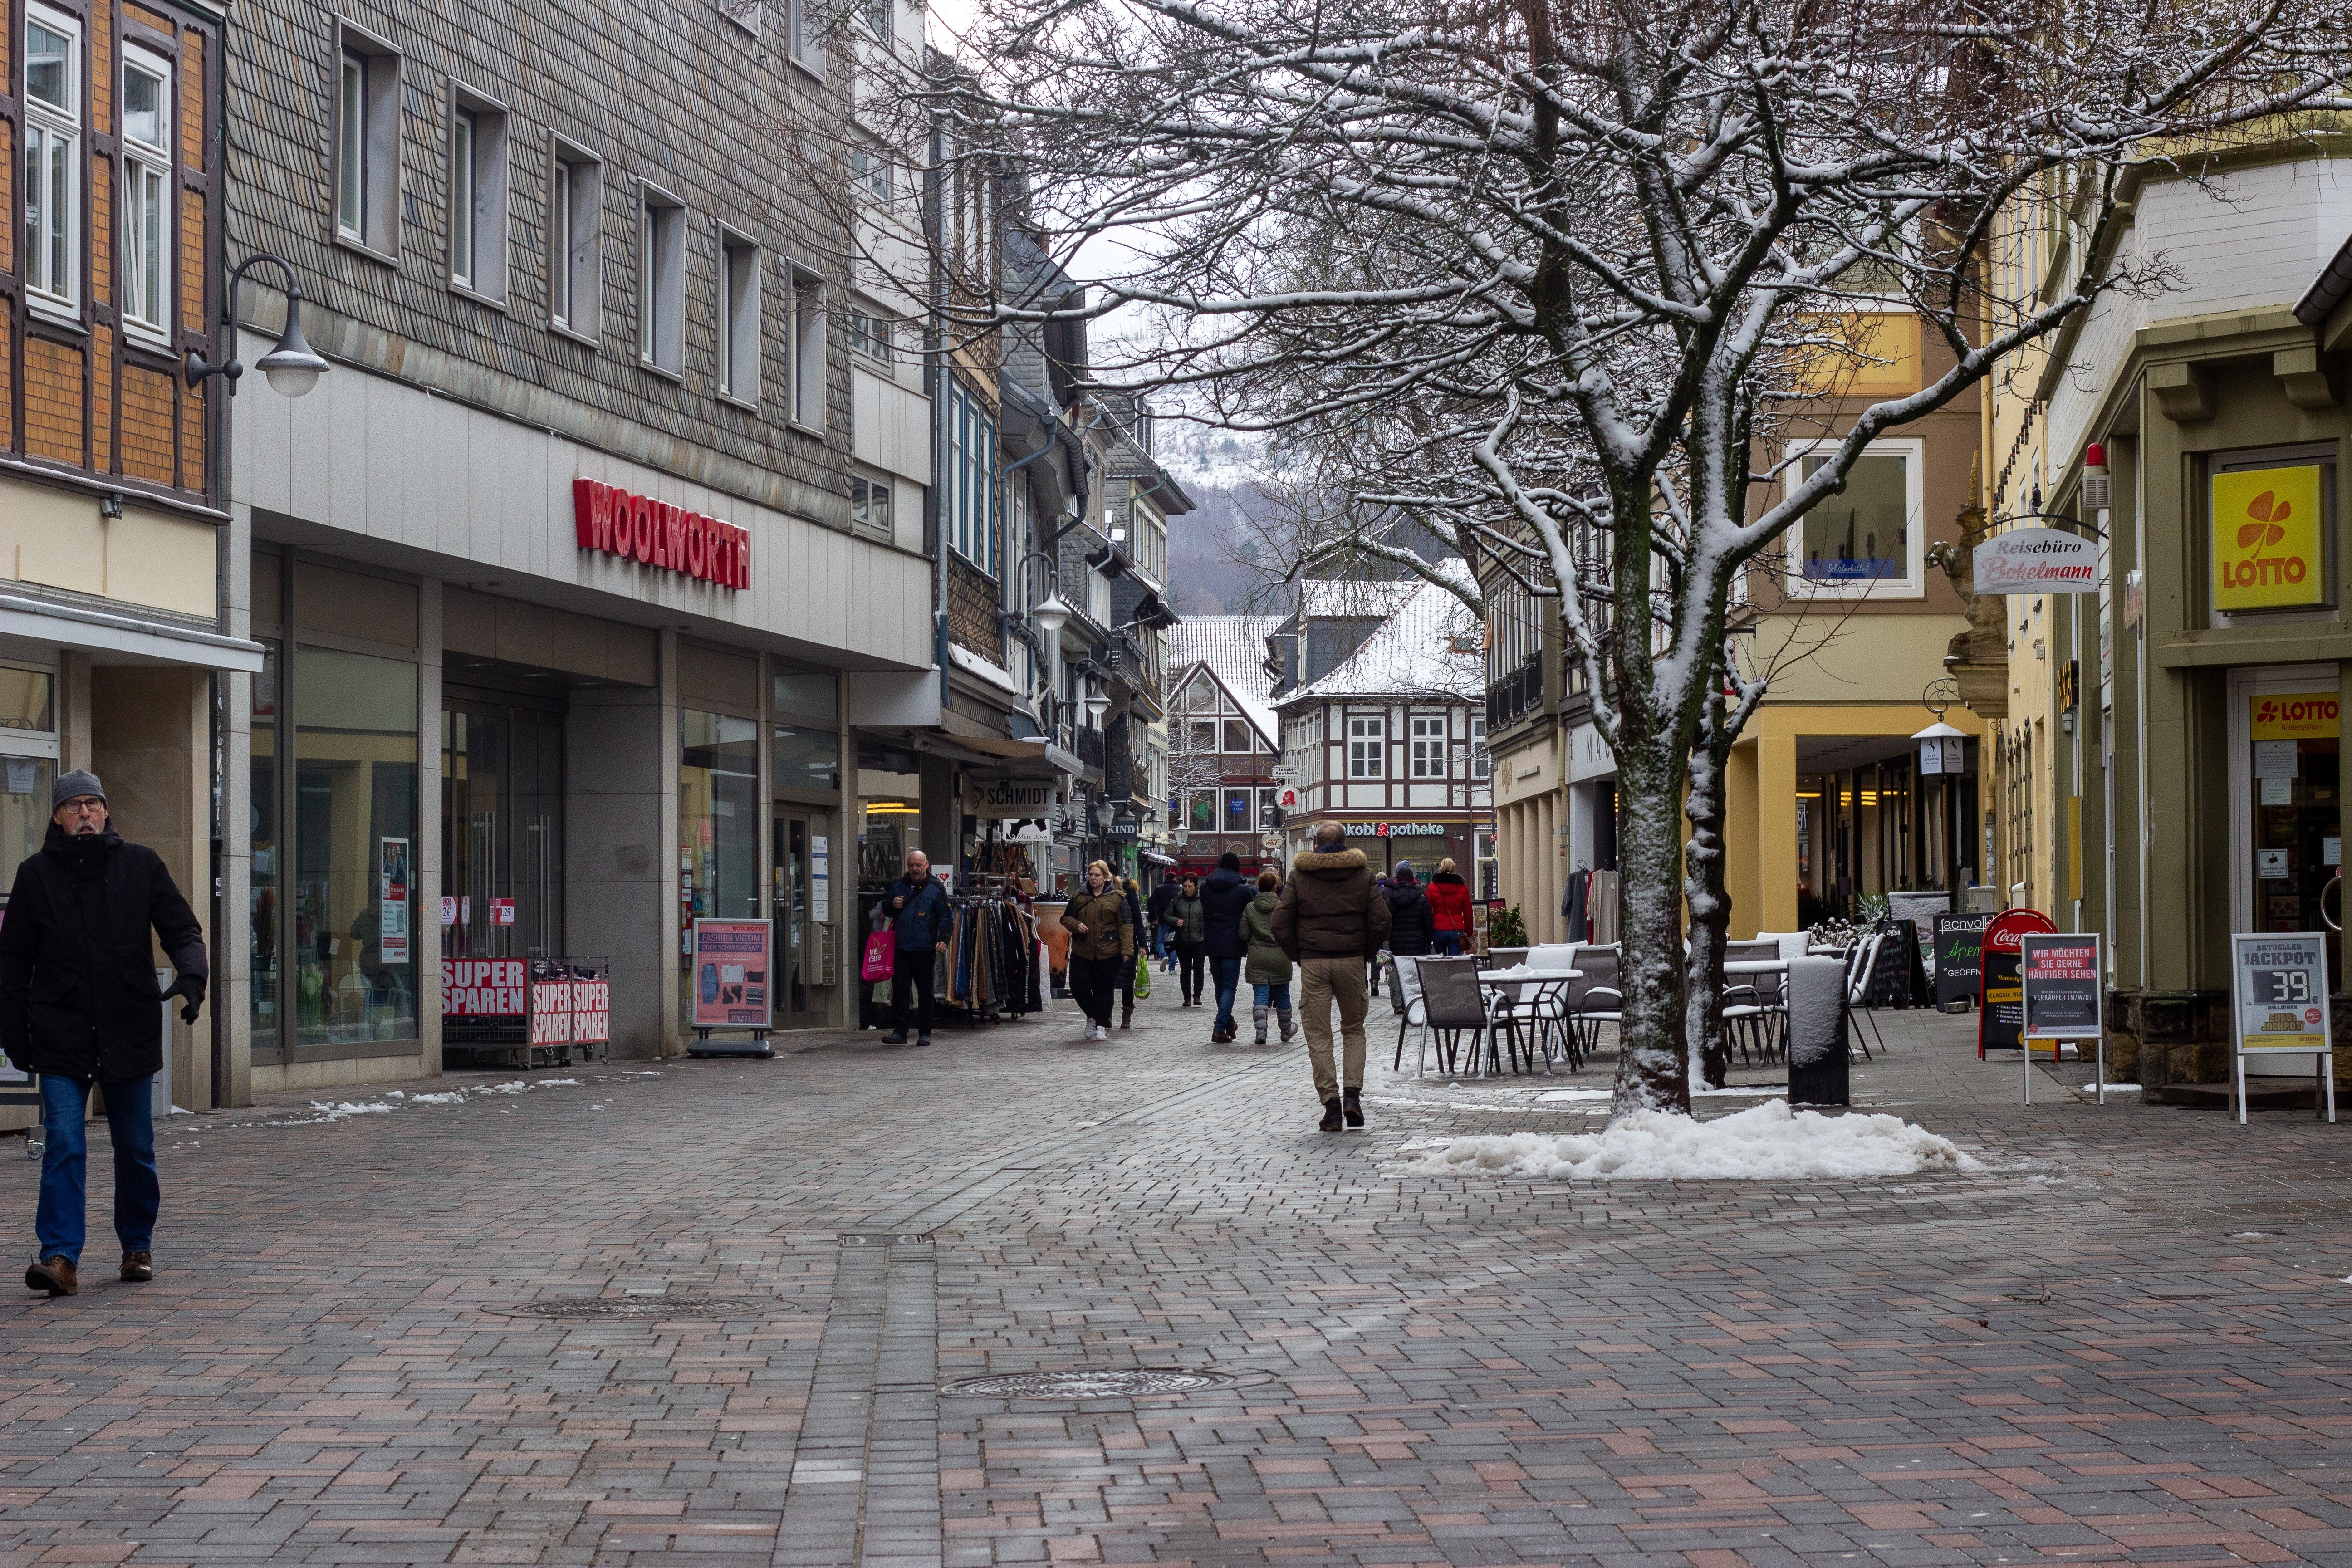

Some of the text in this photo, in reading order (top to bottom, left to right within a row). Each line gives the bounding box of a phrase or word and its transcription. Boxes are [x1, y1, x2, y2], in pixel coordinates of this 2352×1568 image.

[575, 478, 750, 590] WOOLWORTH
[1997, 540, 2082, 554] Reisebüro
[1981, 556, 2092, 582] Bokelmann
[2223, 556, 2306, 589] LOTTO
[2282, 701, 2339, 721] LOTTO
[988, 787, 1049, 805] SCHMIDT
[1107, 825, 1135, 833] KIND
[1345, 823, 1375, 836] kobi
[443, 907, 451, 917] 2€
[500, 908, 510, 917] 1.25
[868, 954, 881, 963] care
[2033, 948, 2090, 958] WIR MÖCHTEN
[2244, 952, 2316, 966] JACKPOT
[2041, 959, 2082, 968] SIE GERNE
[442, 962, 524, 987] SUPER
[1998, 975, 2022, 983] Homestyl
[2029, 969, 2096, 979] HÄUFIGER SEHEN
[2272, 972, 2308, 1001] 39
[442, 988, 524, 1014] SPAREN
[533, 984, 571, 1014] SUPER
[574, 983, 609, 1012] SUPER
[532, 1013, 571, 1044] SPAREN
[574, 1012, 609, 1041] SPAREN
[2261, 1021, 2305, 1031] JACKPOT
